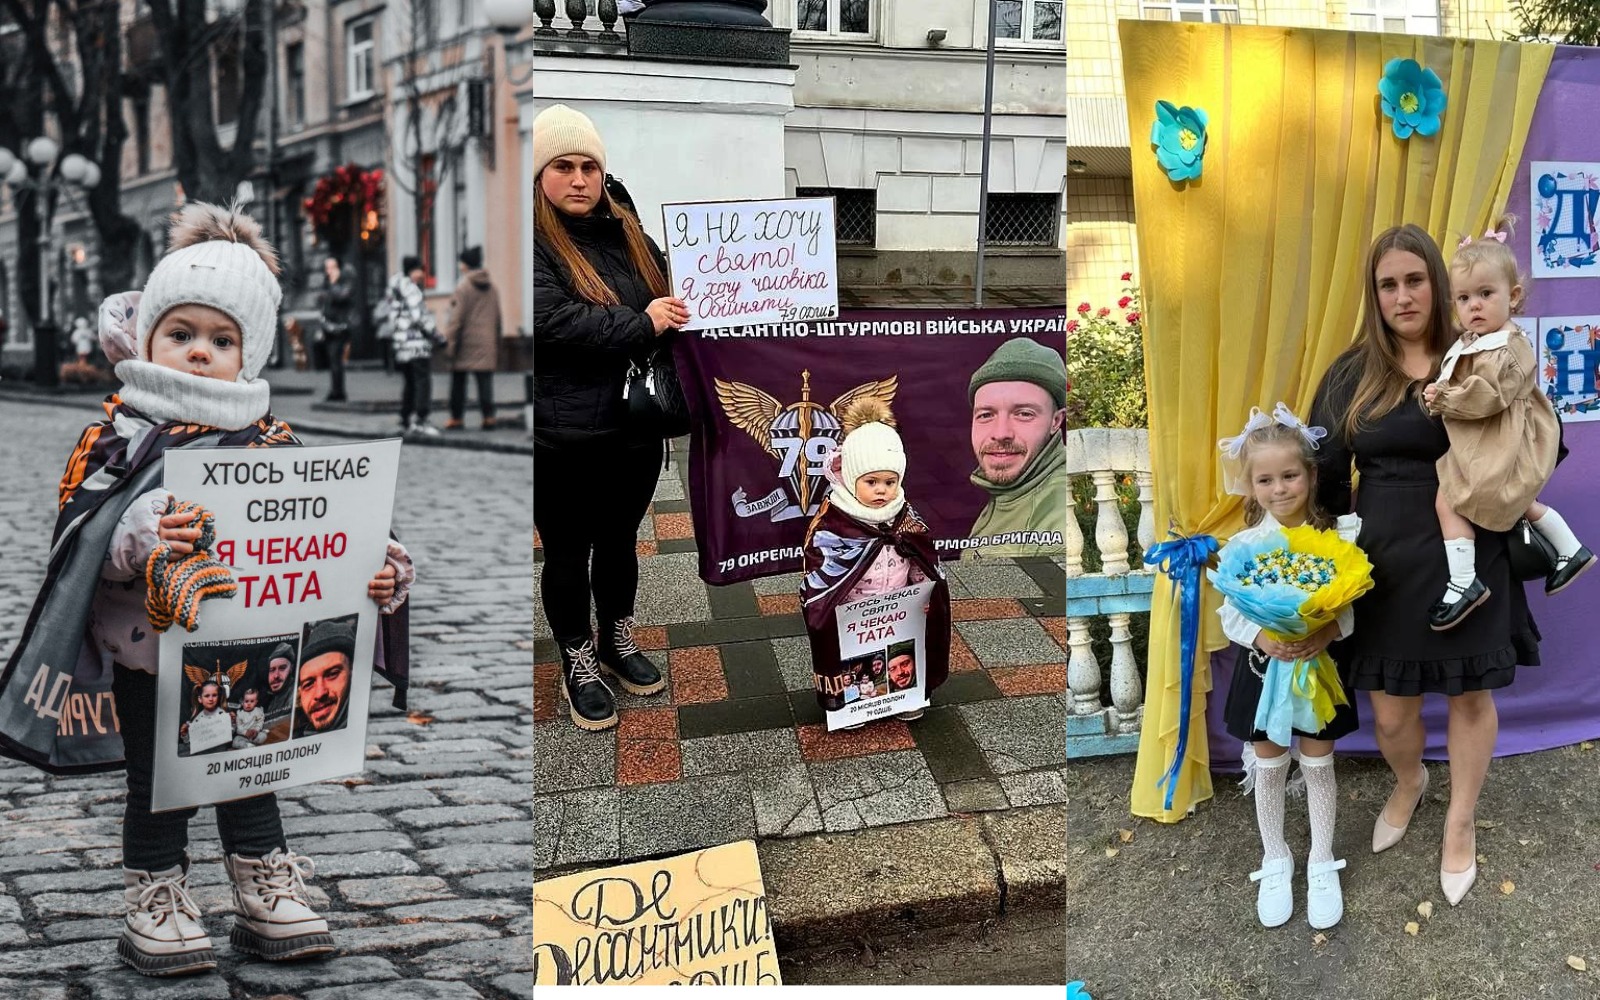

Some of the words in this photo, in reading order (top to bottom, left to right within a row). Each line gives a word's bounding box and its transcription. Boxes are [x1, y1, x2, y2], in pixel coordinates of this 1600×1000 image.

[673, 212, 699, 247] Я
[680, 277, 699, 301] Я
[703, 280, 741, 303] хочу
[752, 267, 829, 290] чоловіка
[778, 307, 797, 321] 79
[925, 317, 1006, 335] ВІЙСЬКА
[1010, 315, 1066, 334] УКРАЇ
[771, 437, 838, 477] 79
[202, 462, 284, 485] ХТОСЬ
[293, 457, 371, 483] ЧЕКАЄ
[246, 497, 328, 522] СВЯТО
[216, 540, 235, 566] Я
[246, 532, 347, 565] ЧЕКАЮ
[933, 537, 989, 550] РМОВА
[992, 531, 1063, 546] БРИГАДА
[719, 559, 735, 573] 79
[738, 547, 804, 568] ОКРЕМА
[238, 571, 322, 608] ТАТА
[845, 599, 881, 612] ХТОСЬ
[884, 588, 920, 602] ЧЕКАЄ
[847, 623, 856, 632] Я
[860, 611, 907, 628] ЧЕКАЮ
[862, 602, 899, 617] СВЯТО
[857, 626, 895, 644] ТАТА
[207, 763, 221, 775] 20
[224, 752, 273, 773] МІСЯЦІВ
[276, 743, 322, 763] ПОЛОНУ
[239, 776, 252, 789] 79
[254, 768, 290, 786] ОДШБ
[571, 870, 677, 929] Де
